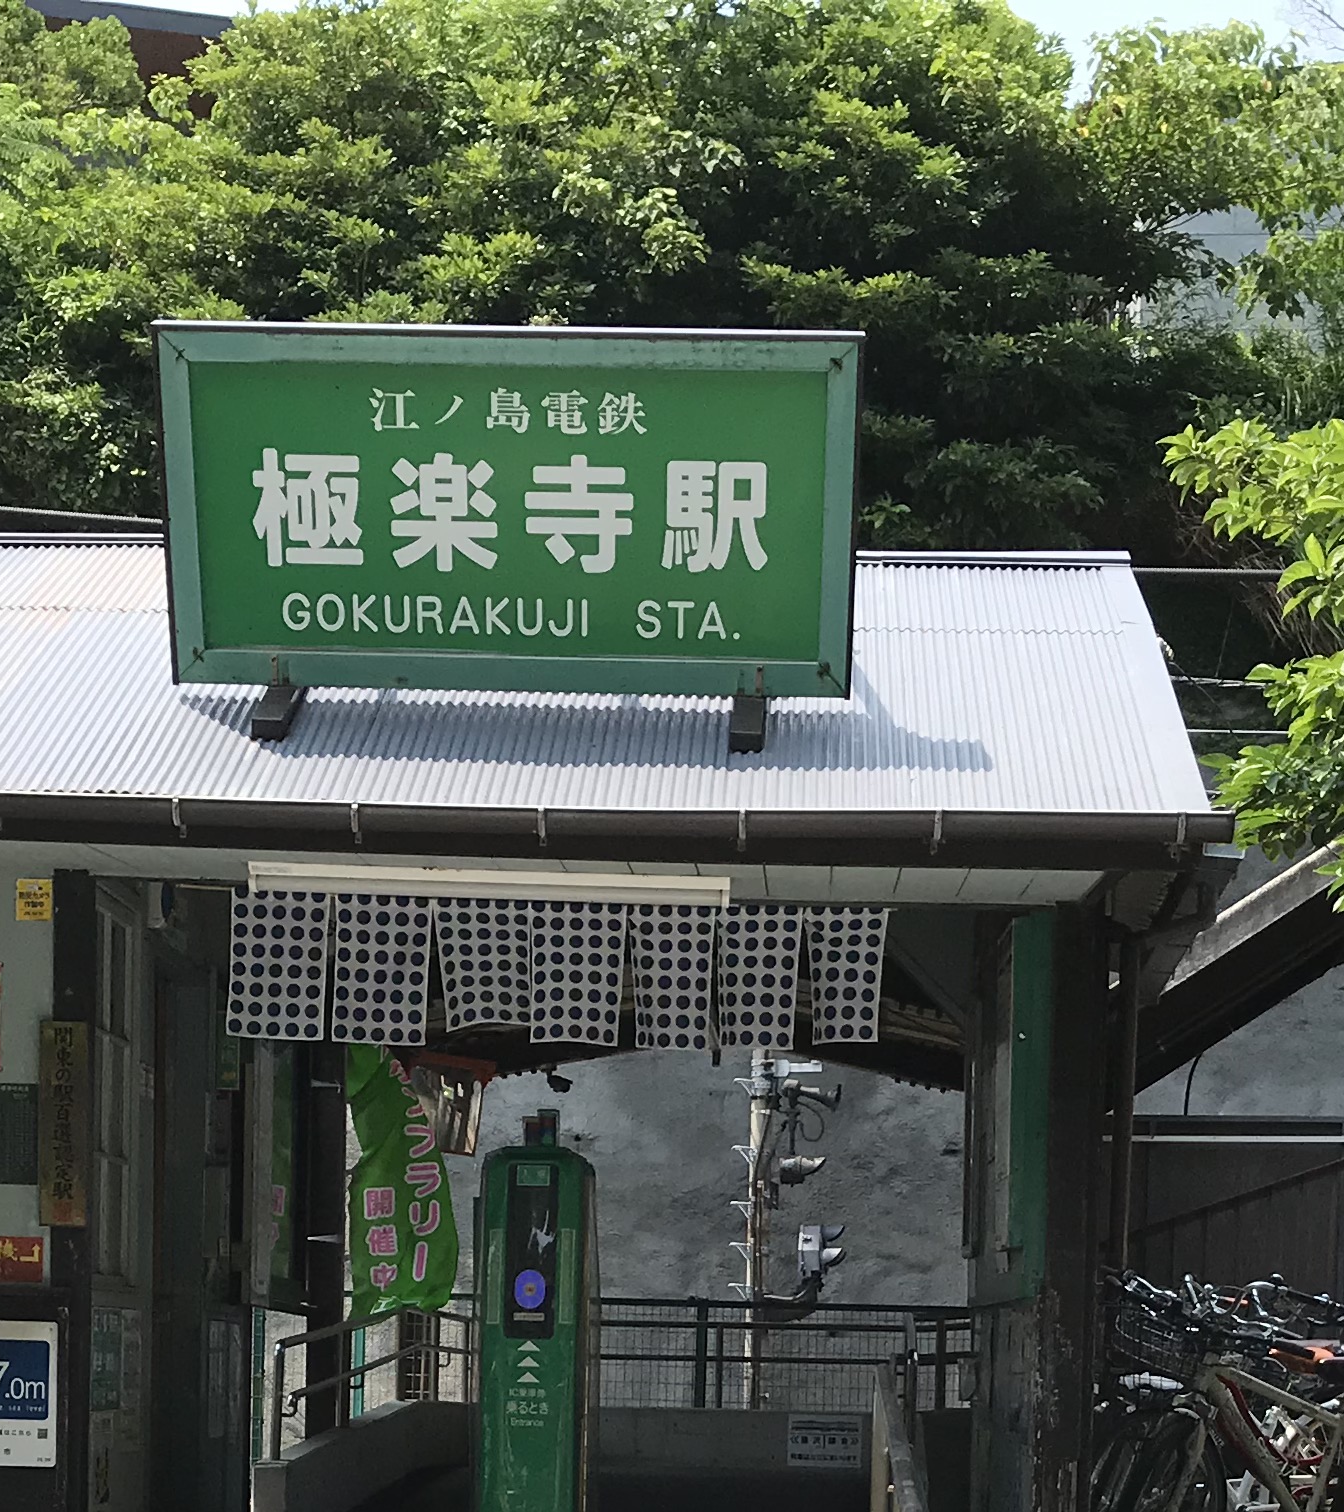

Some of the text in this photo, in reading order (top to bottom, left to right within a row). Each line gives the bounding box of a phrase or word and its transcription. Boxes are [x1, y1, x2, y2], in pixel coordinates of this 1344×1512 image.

[368, 387, 648, 435] 江ノ島電鉄
[251, 447, 769, 574] 極楽寺駅
[282, 593, 742, 641] GOKURAKUJI STA.
[363, 1186, 398, 1293] 開催中
[506, 1400, 549, 1415] 乗るとき
